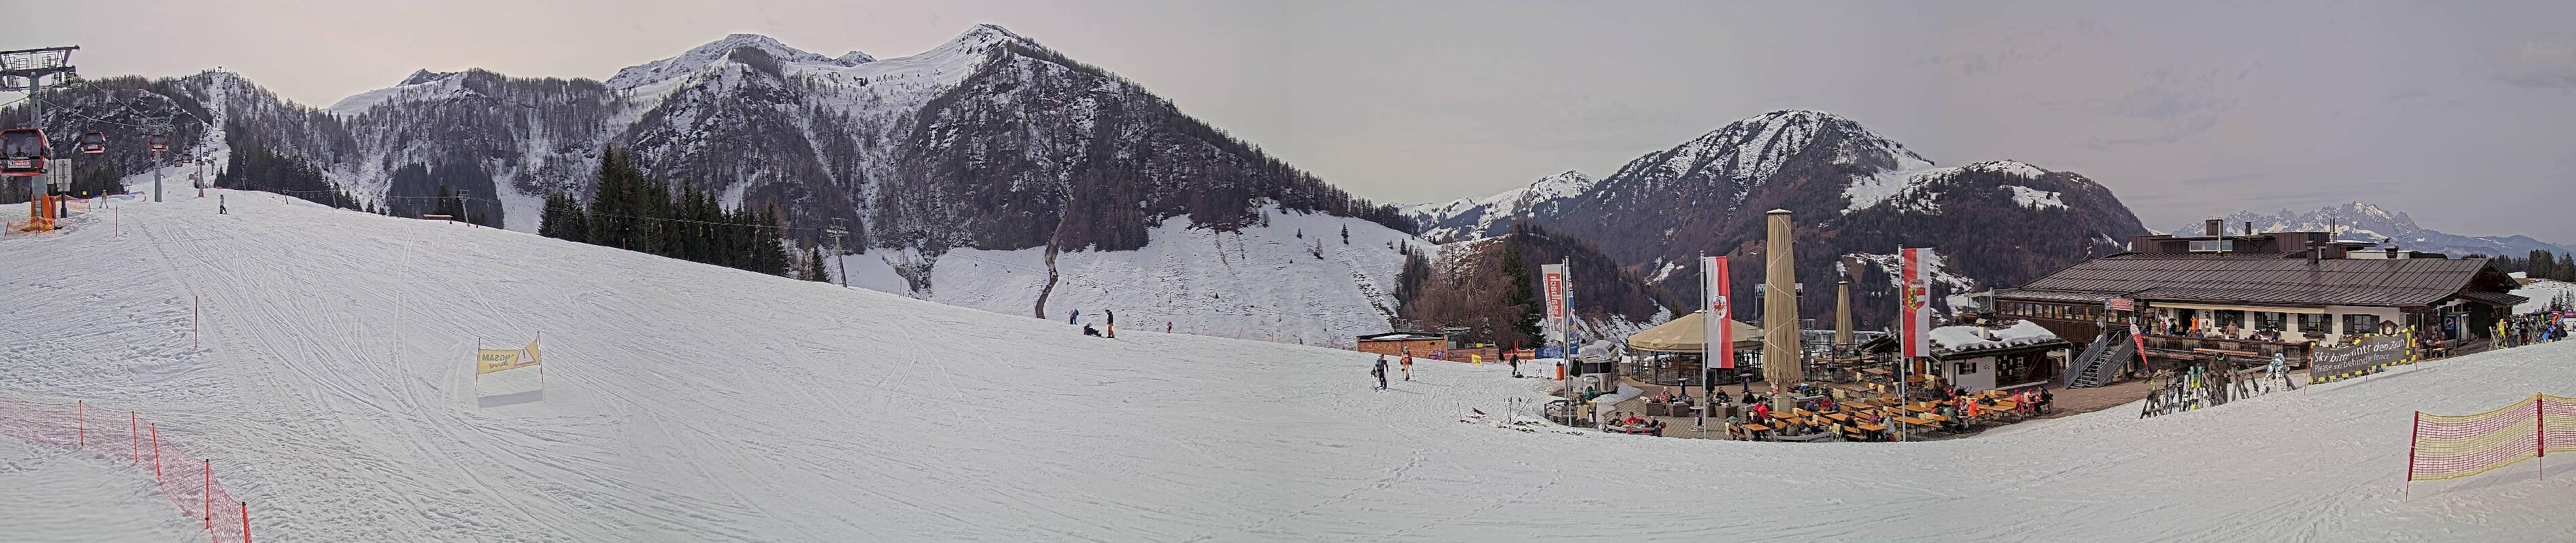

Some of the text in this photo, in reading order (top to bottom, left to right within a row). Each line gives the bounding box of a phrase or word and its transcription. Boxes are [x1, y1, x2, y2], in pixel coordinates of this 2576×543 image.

[2315, 352, 2328, 362] Ski
[2373, 341, 2389, 352] den
[2315, 364, 2332, 373] Please
[2343, 356, 2368, 368] behind
[2373, 352, 2390, 360] fence
